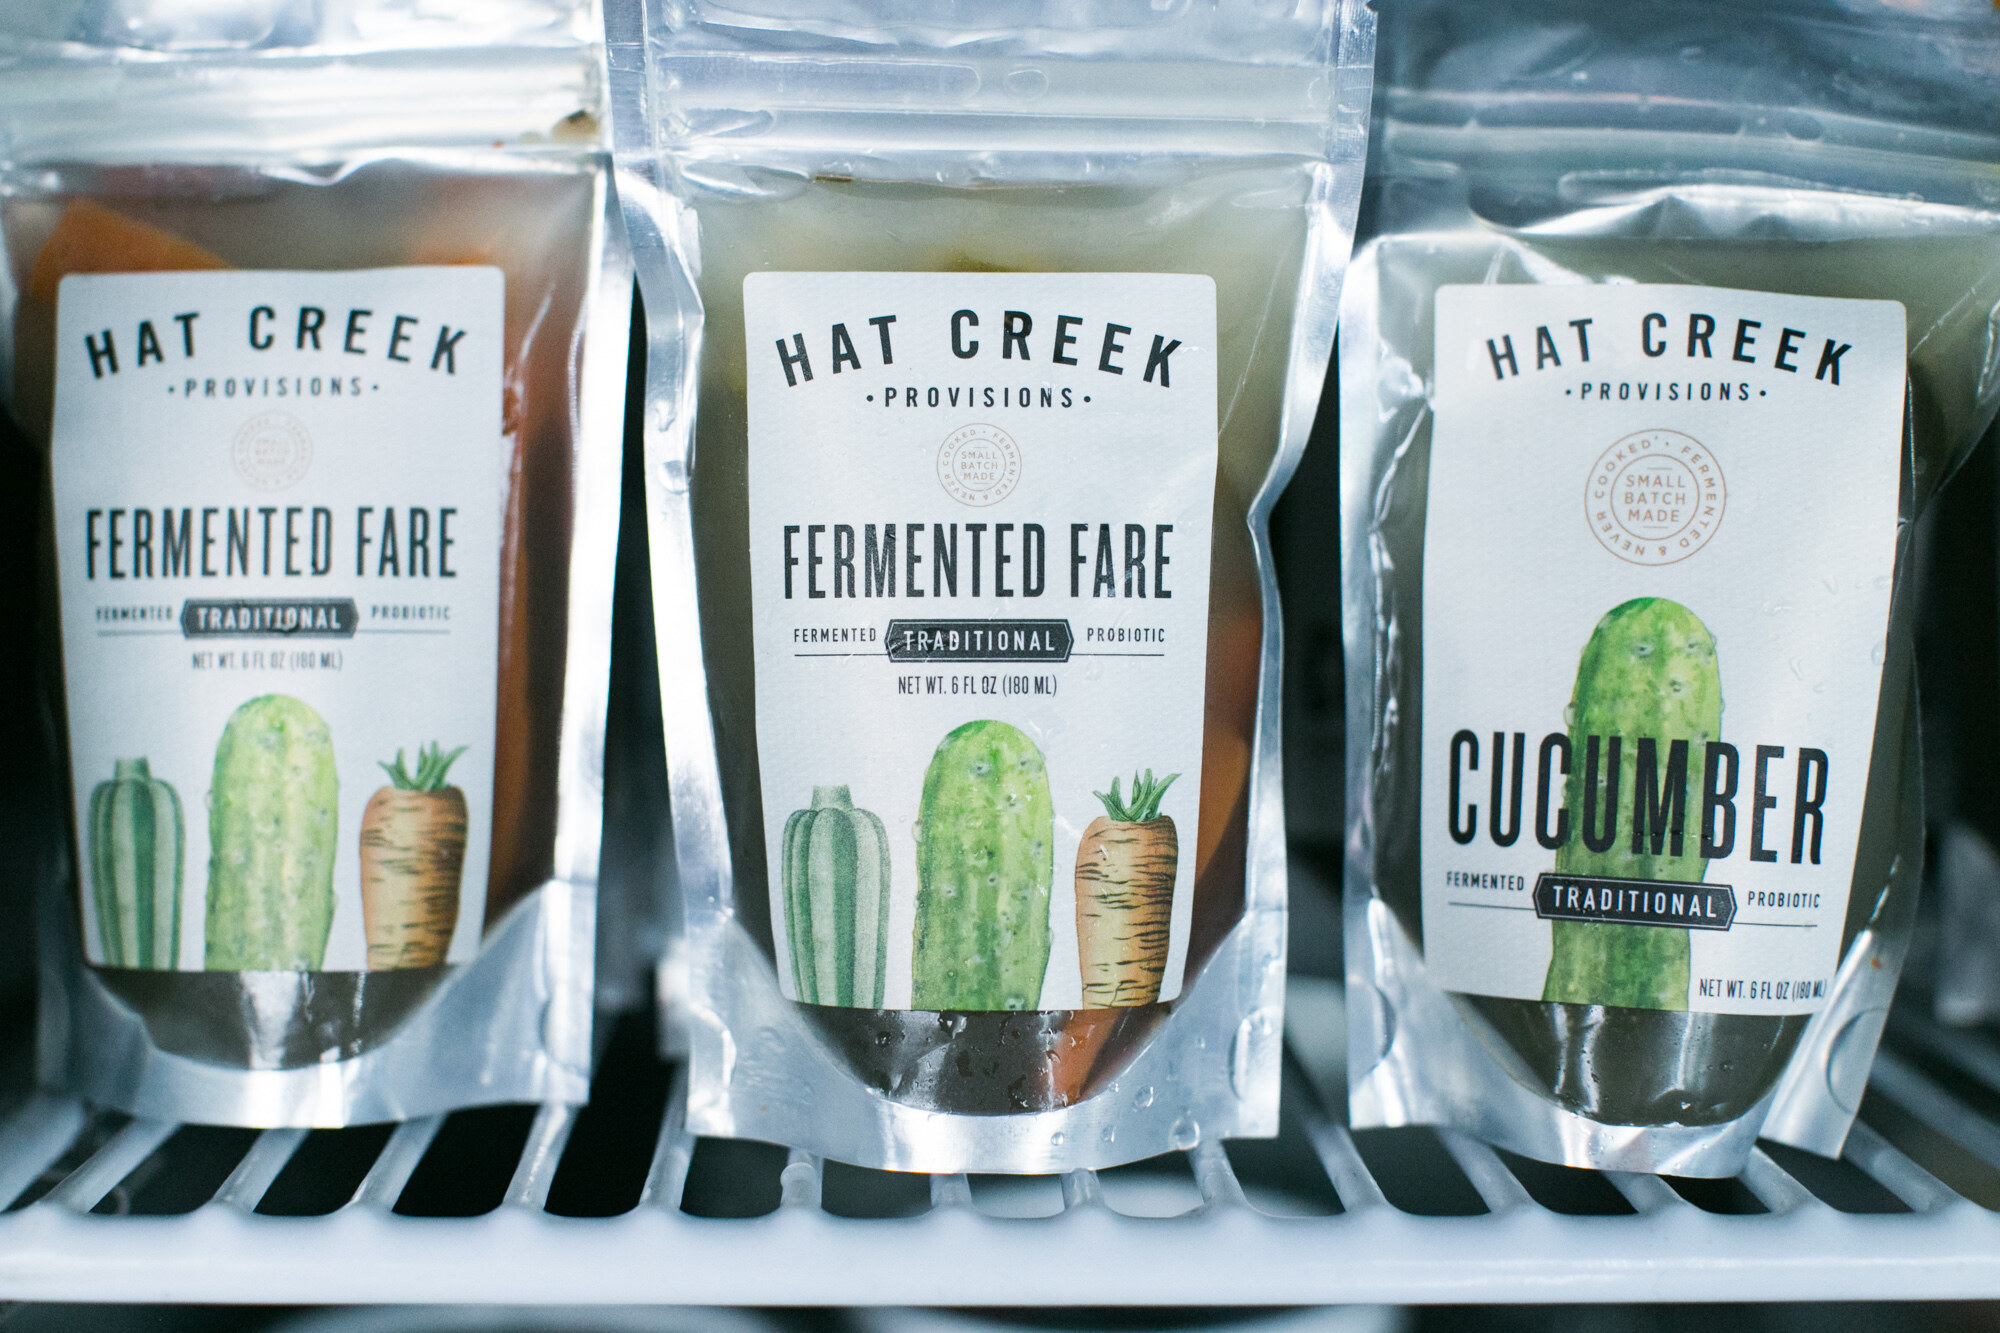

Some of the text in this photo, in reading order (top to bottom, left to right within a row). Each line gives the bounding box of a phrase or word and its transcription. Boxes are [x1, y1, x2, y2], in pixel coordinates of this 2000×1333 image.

[85, 305, 467, 378] HAT CREEK
[775, 308, 1182, 388] HAT CREEK
[1485, 312, 1853, 386] HAT CREEK
[185, 376, 362, 398] PROVISIONS
[884, 386, 1073, 408] PROVISIONS
[1581, 382, 1750, 401] PROVISIONS
[961, 450, 998, 459] SMALL
[961, 462, 998, 470] BATCH
[963, 472, 995, 480] MADE
[1594, 439, 1651, 499] COOKED
[1625, 474, 1686, 488] SMALL
[1623, 491, 1686, 505] BATCH
[1679, 445, 1717, 548] FERMENTED
[1627, 508, 1680, 522] MADE
[86, 507, 458, 580] FERMENTED FARE
[1596, 511, 1645, 556] NEVER
[784, 523, 1174, 600] FERMENTED FARE
[96, 604, 451, 630] FERMENTED TRADITIONAL PROBIOTIC
[794, 627, 1166, 652] FERMENTED TRADITIONAL PROBIOTIC
[192, 652, 213, 669] NET
[253, 652, 266, 669] FL
[270, 652, 286, 669] OZ
[320, 651, 344, 671] ML)
[898, 674, 1058, 697] NET WT. 6 FL OZ (180 ML)
[1448, 729, 1829, 865] CUCUMBER
[1446, 870, 1821, 918] FERMENTED TRADITIONAL PROBIOTIC
[1699, 979, 1723, 998] NET
[1726, 980, 1746, 998] WT.
[1750, 980, 1758, 999] 6
[1760, 981, 1772, 1000] FL
[1776, 981, 1790, 1000] OZ
